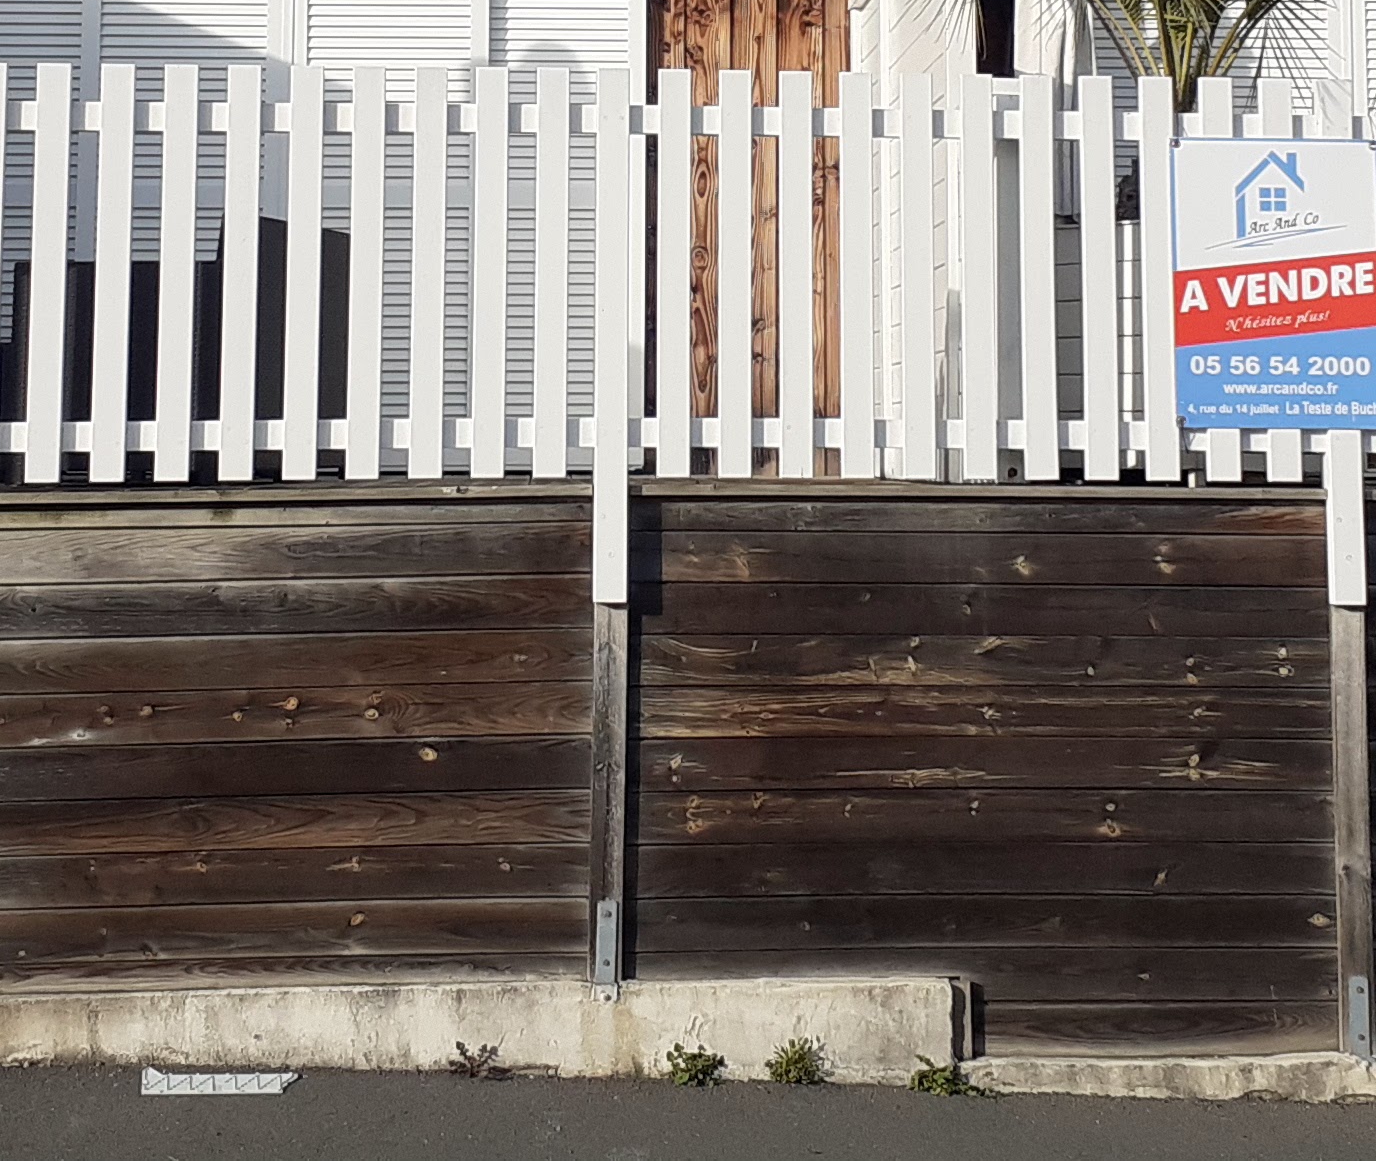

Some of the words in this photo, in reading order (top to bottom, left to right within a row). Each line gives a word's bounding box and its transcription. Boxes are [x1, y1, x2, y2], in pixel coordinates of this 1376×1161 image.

[1247, 220, 1269, 235] Arc
[1272, 216, 1298, 231] And
[1303, 212, 1320, 226] Co
[1180, 280, 1209, 313] A
[1217, 261, 1375, 309] VENDRE
[1294, 310, 1331, 328] plus!
[1190, 355, 1222, 376] 05
[1229, 355, 1261, 376] 56
[1268, 355, 1301, 376] 54
[1307, 356, 1371, 376] 2000
[1223, 382, 1339, 395] www.arcandco.fr
[1200, 405, 1217, 414] rue
[1219, 403, 1233, 414] du
[1235, 403, 1247, 414] 14
[1249, 403, 1280, 416] juillet
[1285, 401, 1300, 415] La
[1303, 401, 1332, 415] Teste
[1334, 402, 1349, 415] de
